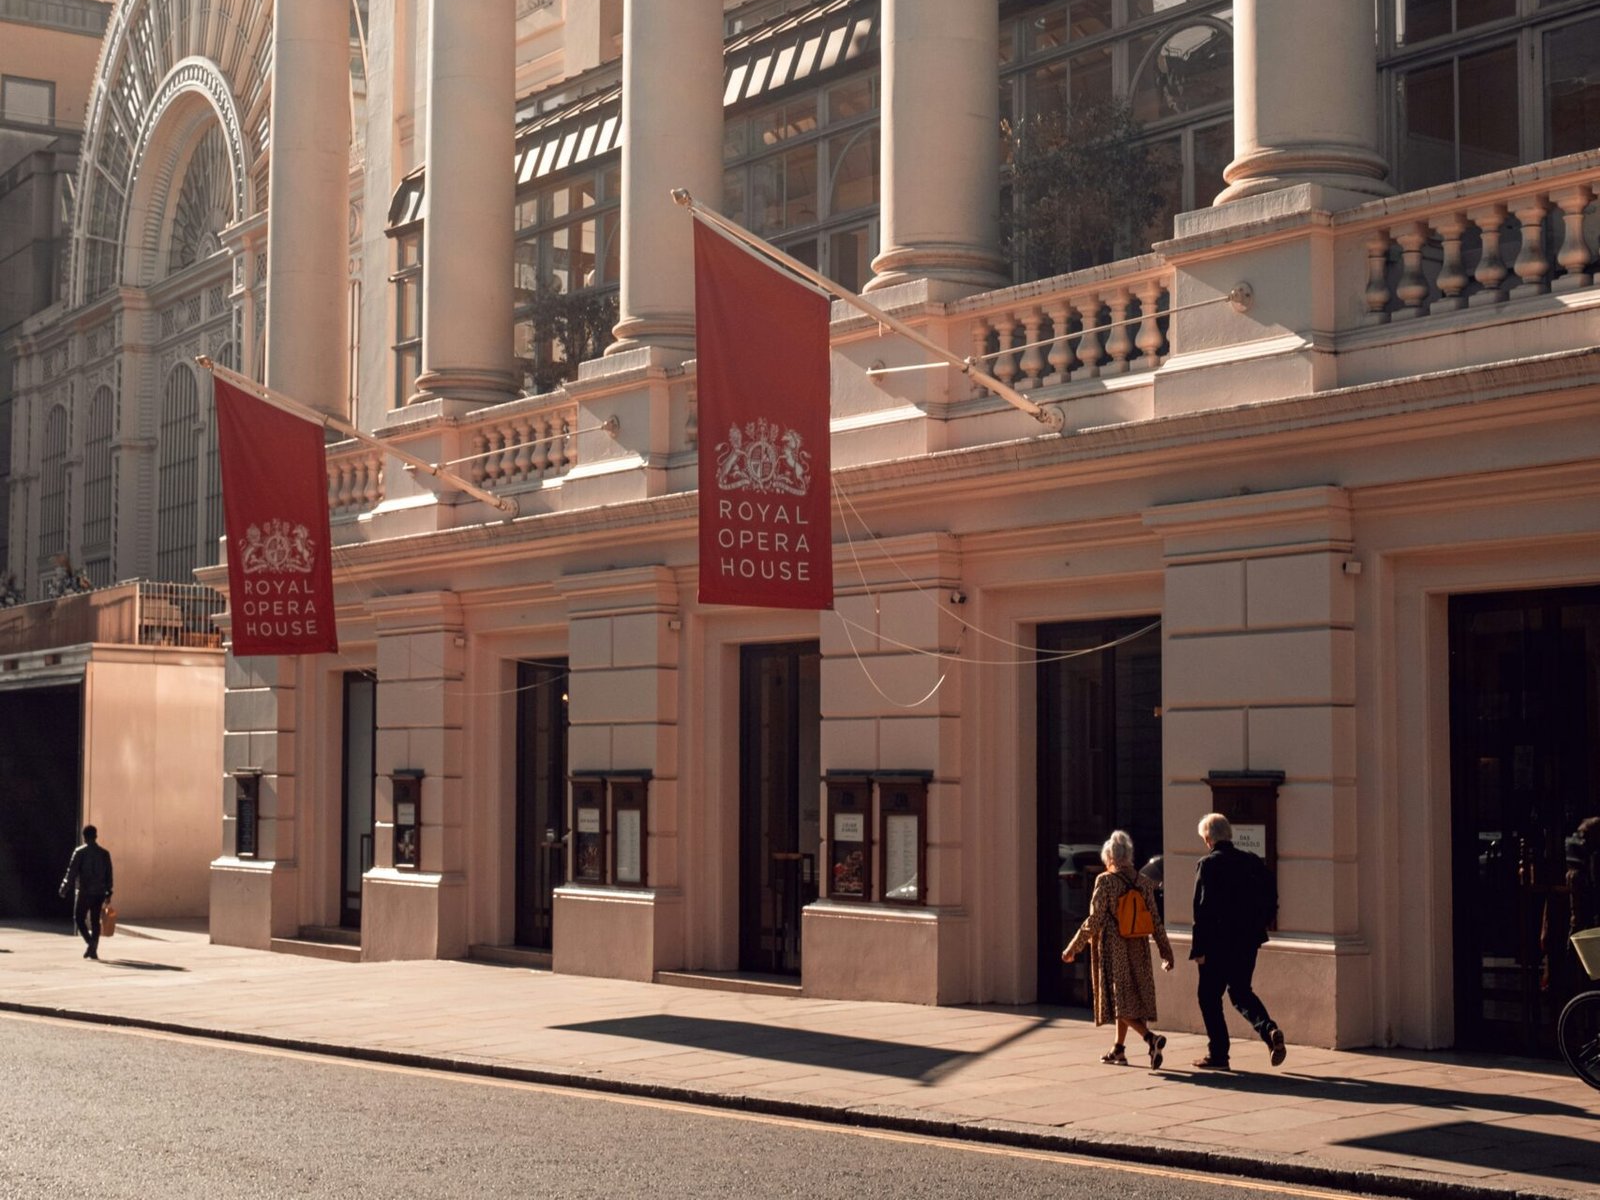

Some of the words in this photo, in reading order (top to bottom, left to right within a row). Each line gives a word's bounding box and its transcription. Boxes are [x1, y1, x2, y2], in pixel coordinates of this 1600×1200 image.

[719, 500, 808, 524] ROYAL
[718, 528, 810, 552] OPERA
[721, 557, 810, 581] HOUSE
[244, 580, 314, 595] ROYAL
[243, 600, 316, 616] OPERA
[246, 620, 317, 636] HOUSE
